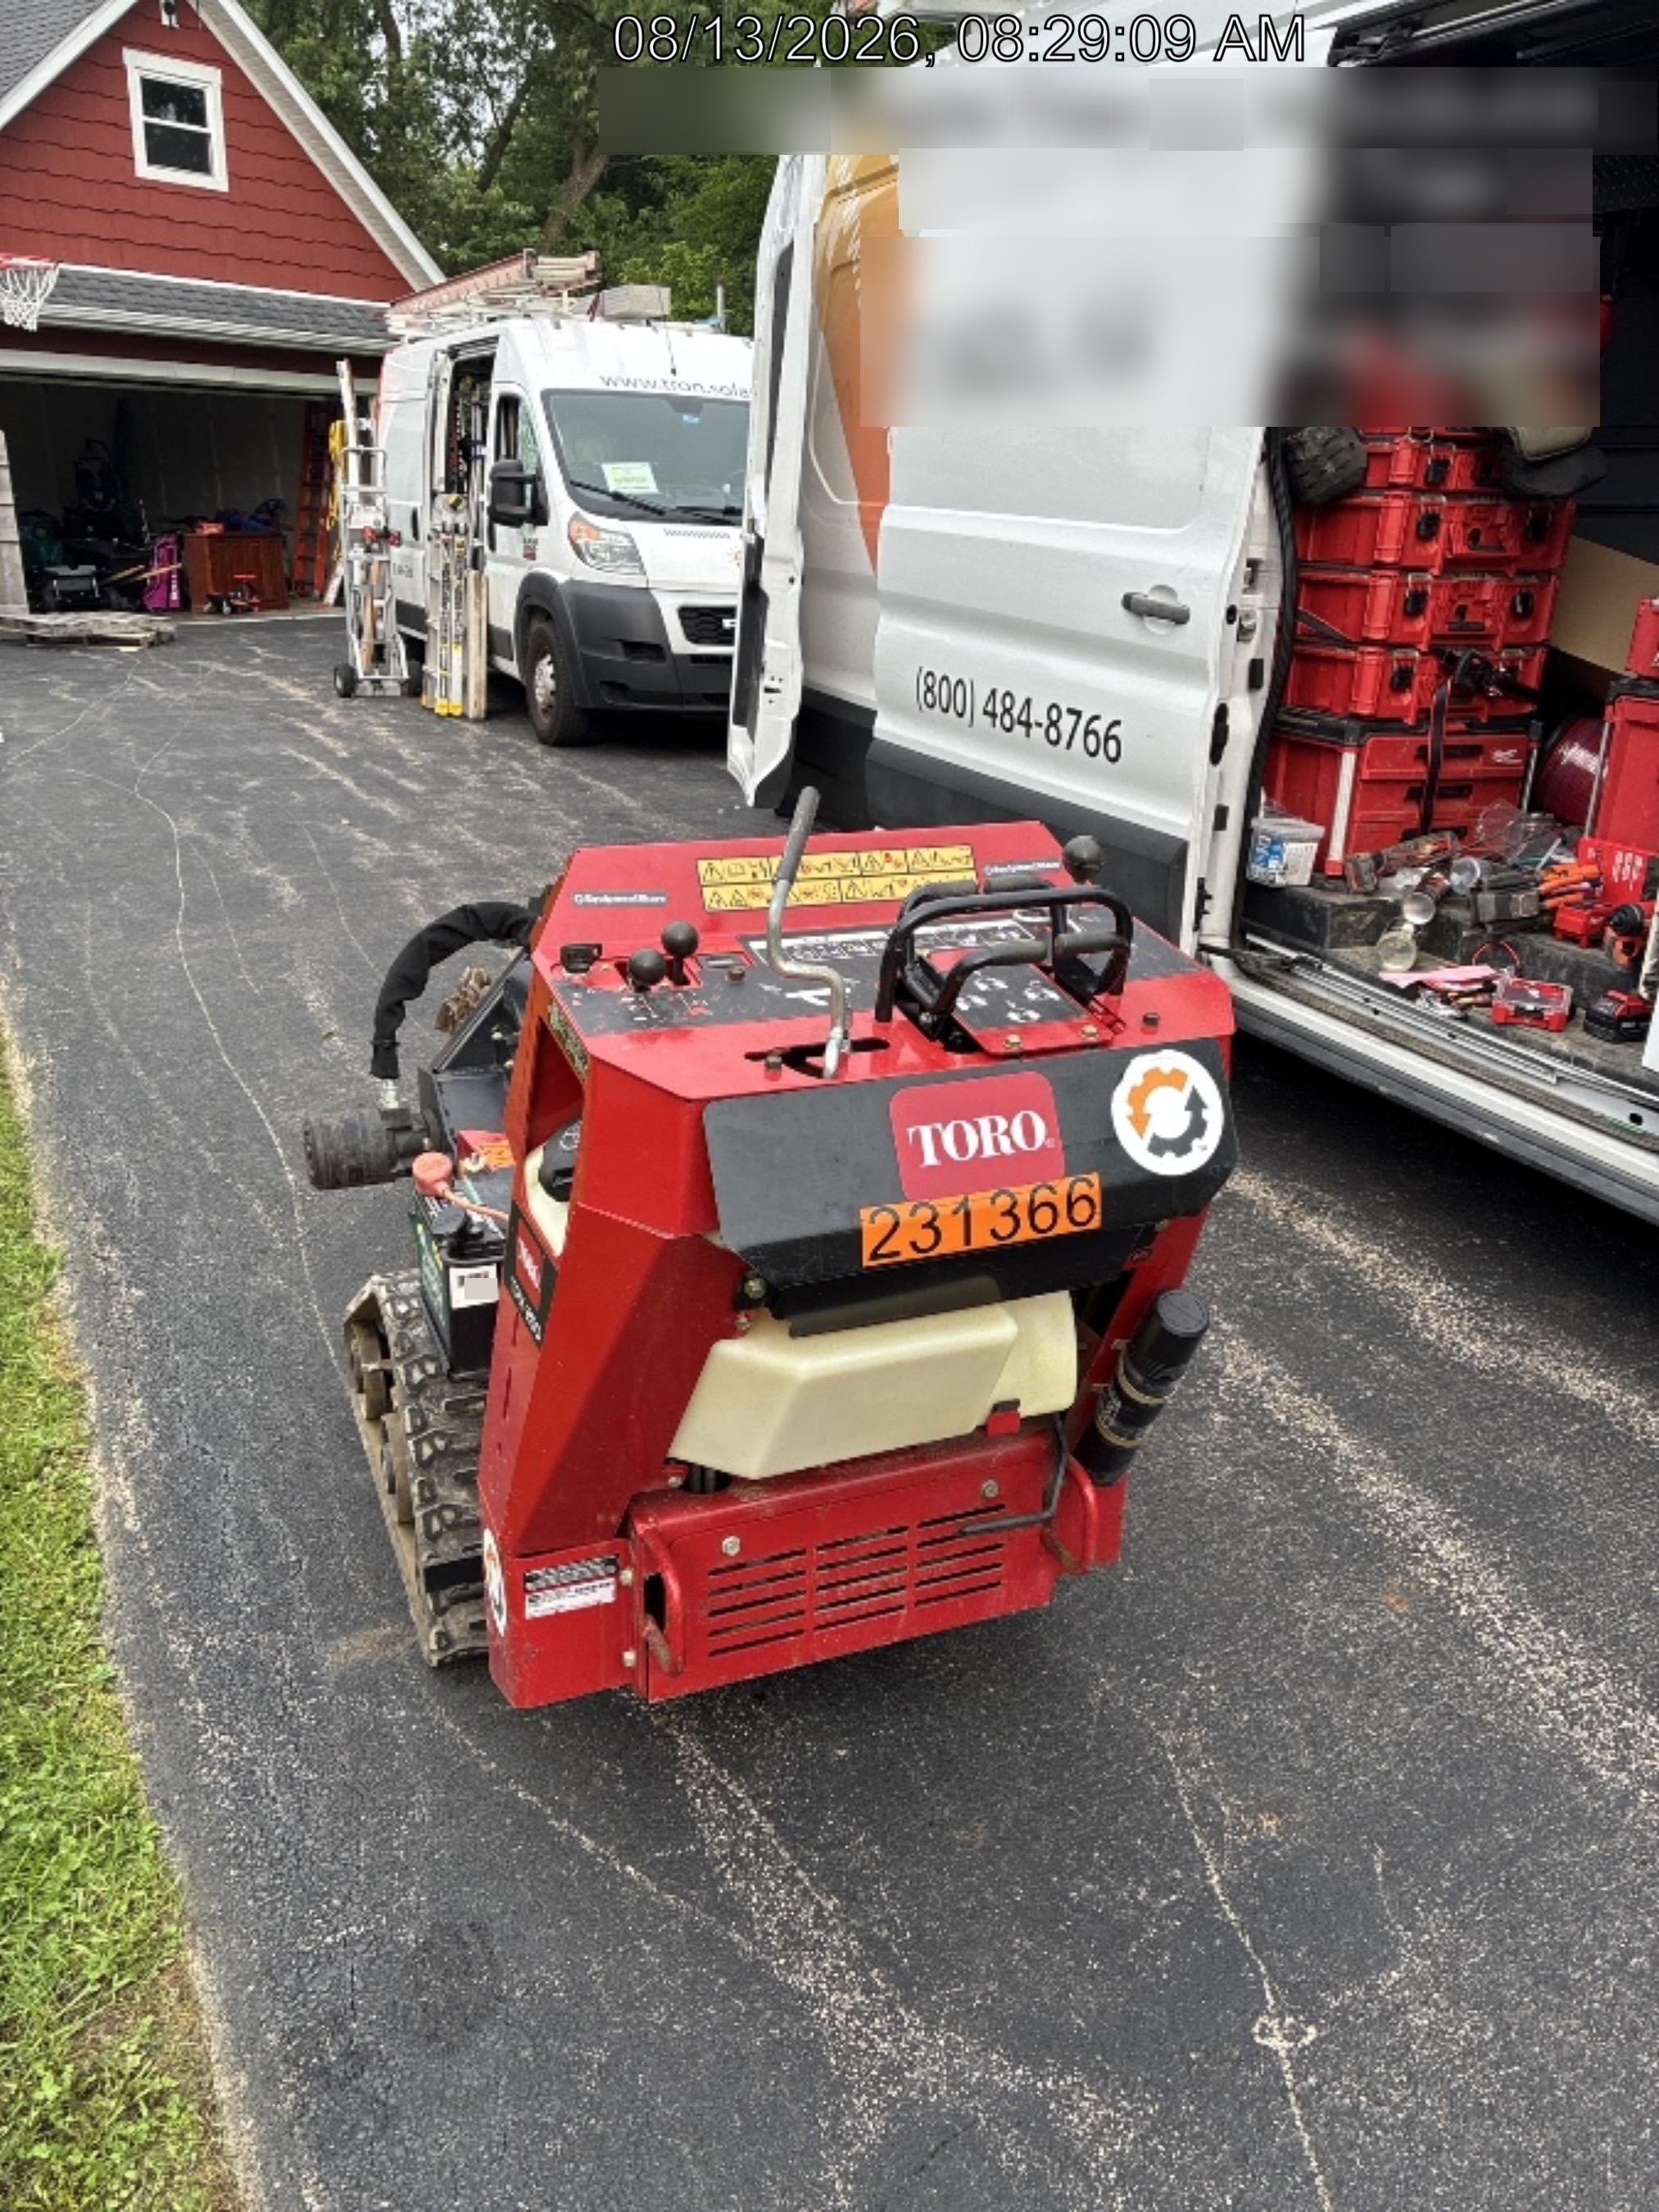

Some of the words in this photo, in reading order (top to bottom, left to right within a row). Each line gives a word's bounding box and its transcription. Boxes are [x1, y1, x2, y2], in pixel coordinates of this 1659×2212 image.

[600, 375, 752, 399] www.tron.sola
[916, 666, 973, 728] (800)
[983, 688, 1122, 763] 484-8766
[907, 1110, 1046, 1167] TORO
[868, 1176, 1096, 1261] 231366
